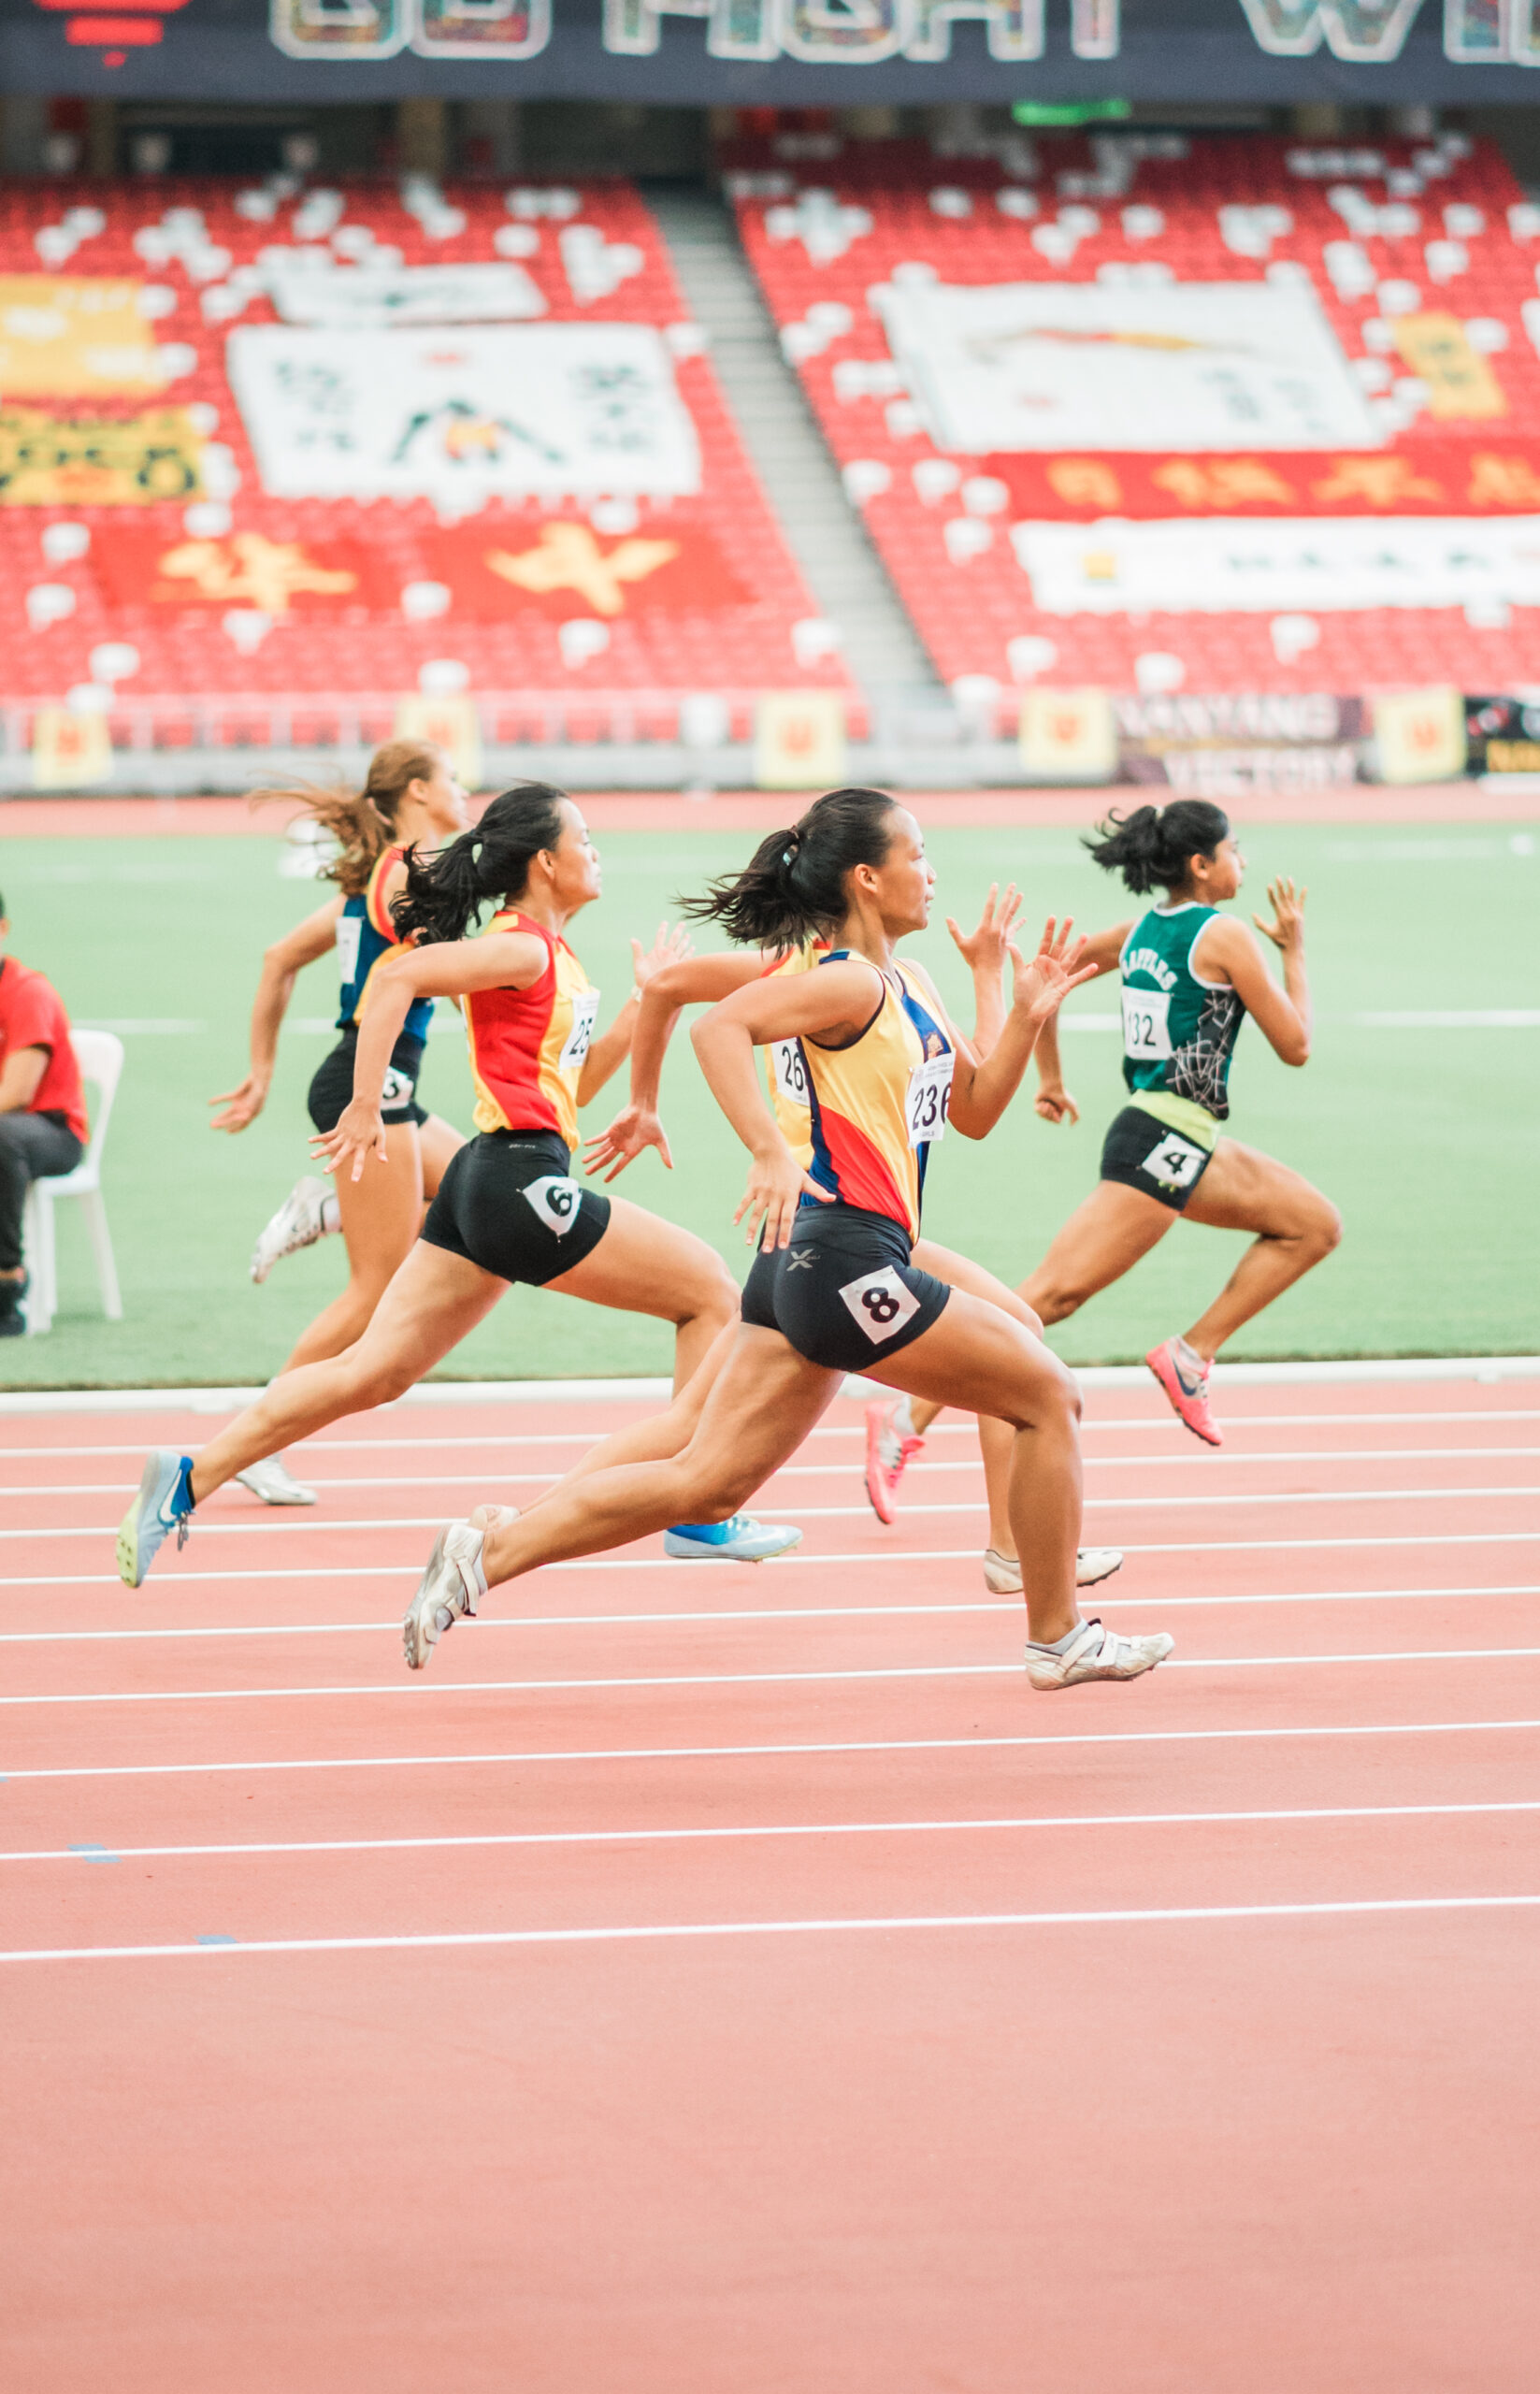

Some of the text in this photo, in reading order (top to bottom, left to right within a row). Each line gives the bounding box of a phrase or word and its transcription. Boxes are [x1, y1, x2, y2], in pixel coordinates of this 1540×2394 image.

[1162, 1151, 1187, 1175] 4
[546, 1185, 573, 1217] 6
[861, 1287, 900, 1323] 8
